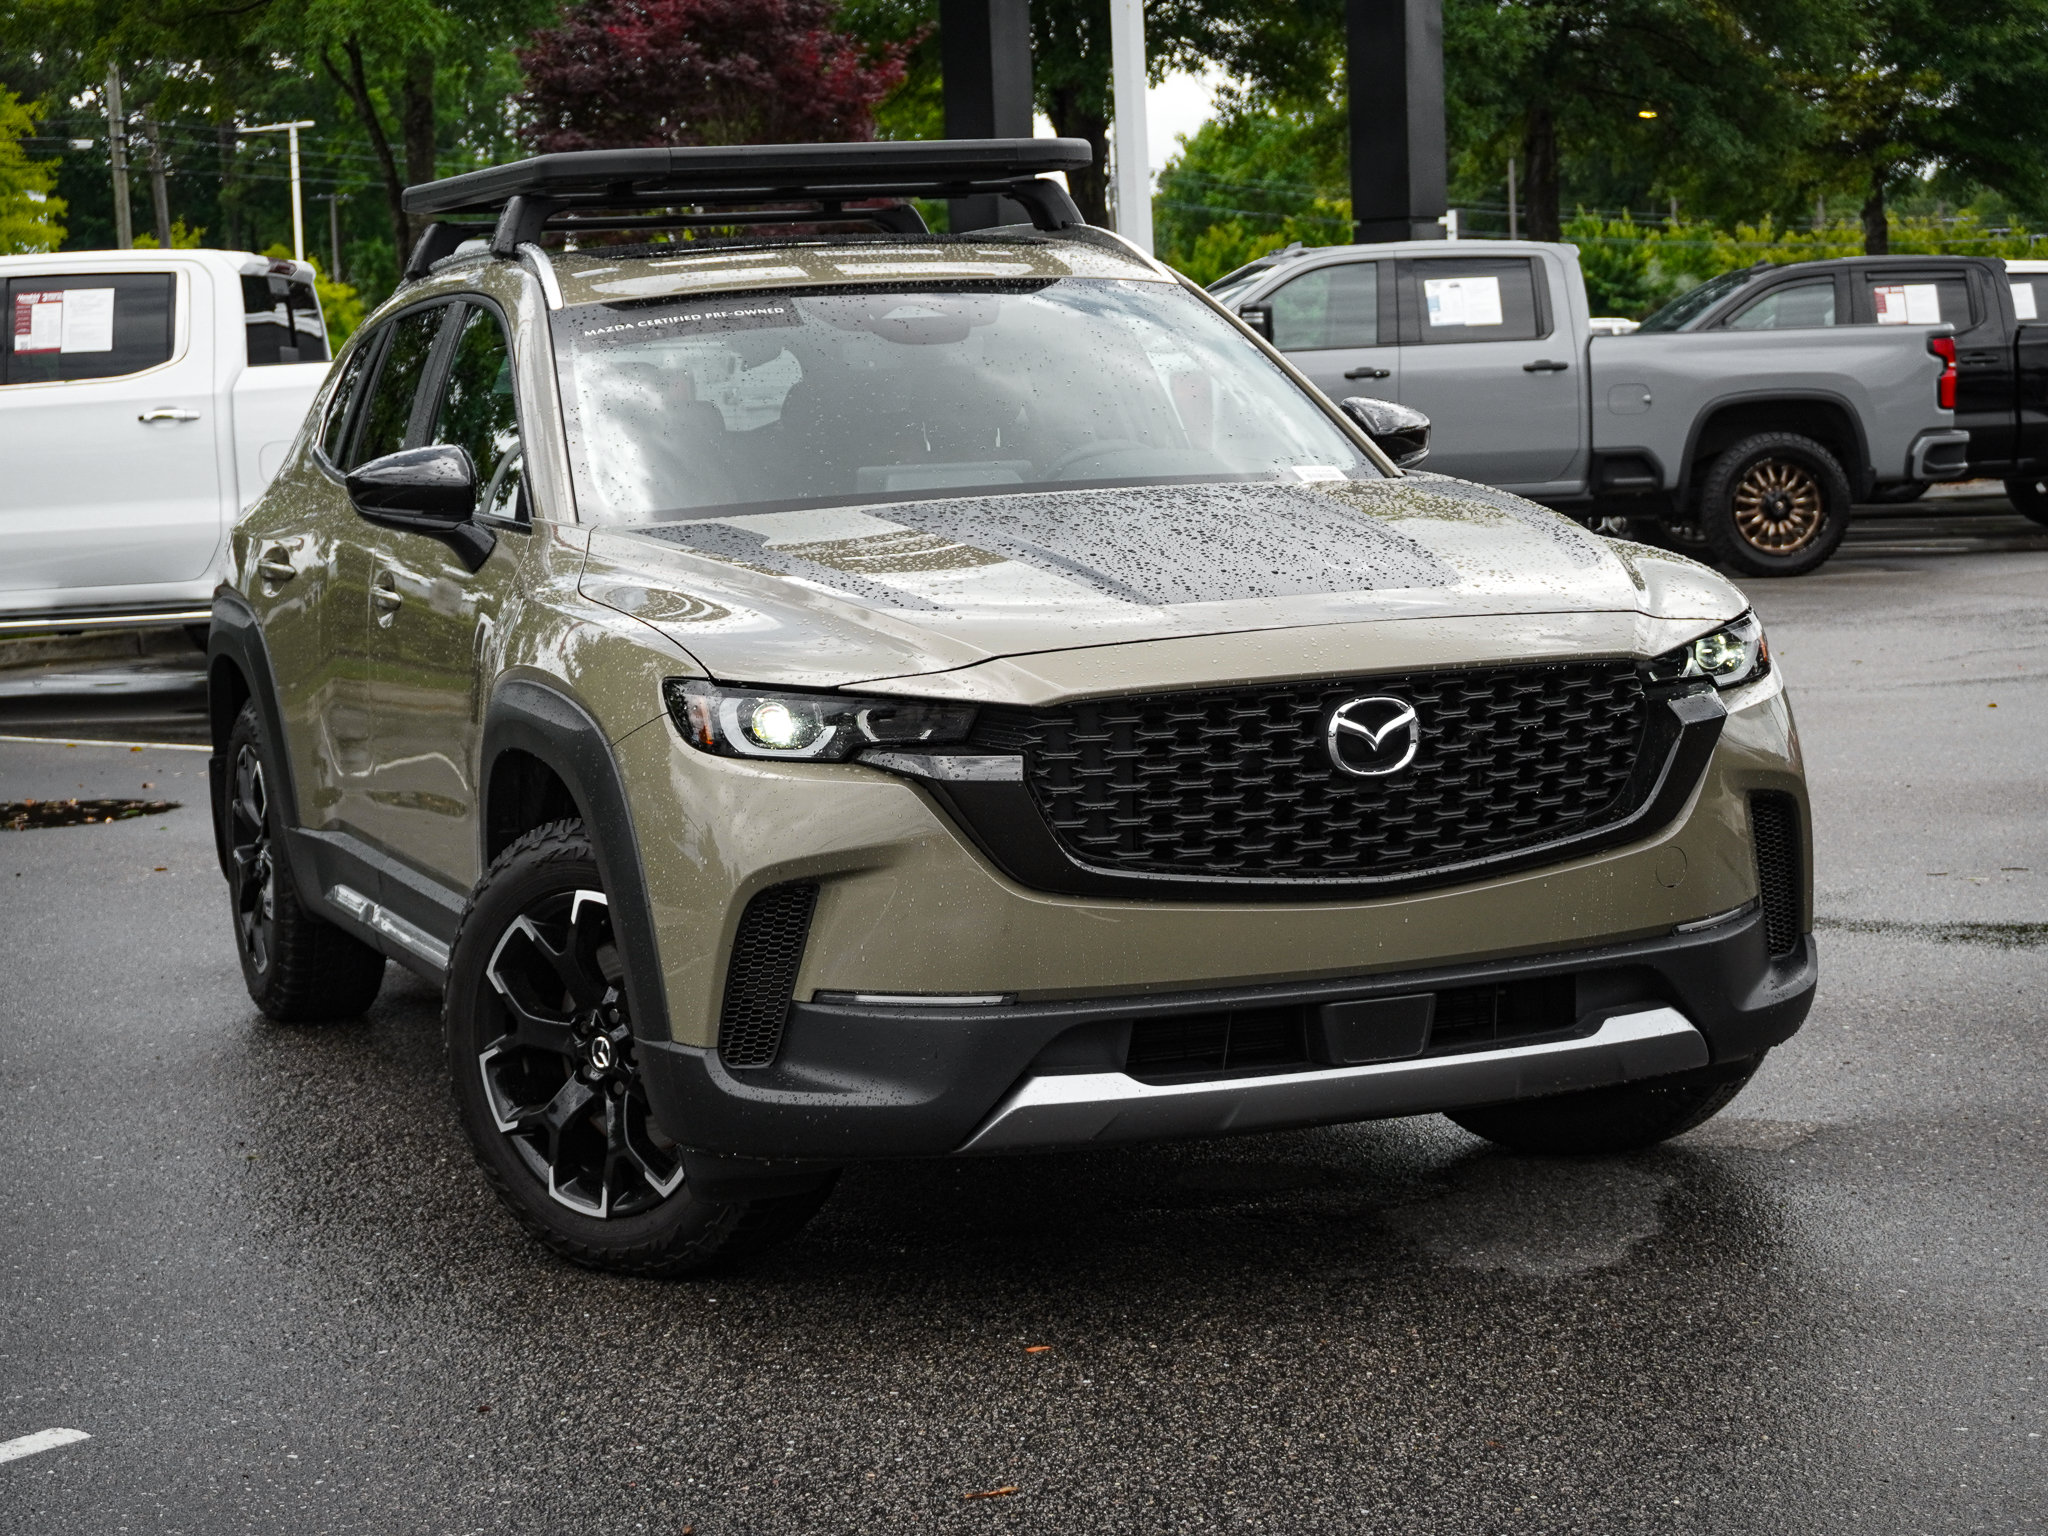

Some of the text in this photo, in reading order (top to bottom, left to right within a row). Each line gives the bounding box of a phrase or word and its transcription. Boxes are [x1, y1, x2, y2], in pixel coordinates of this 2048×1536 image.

[584, 307, 785, 337] MAZDA CERTIFIED PRE-OWNED
